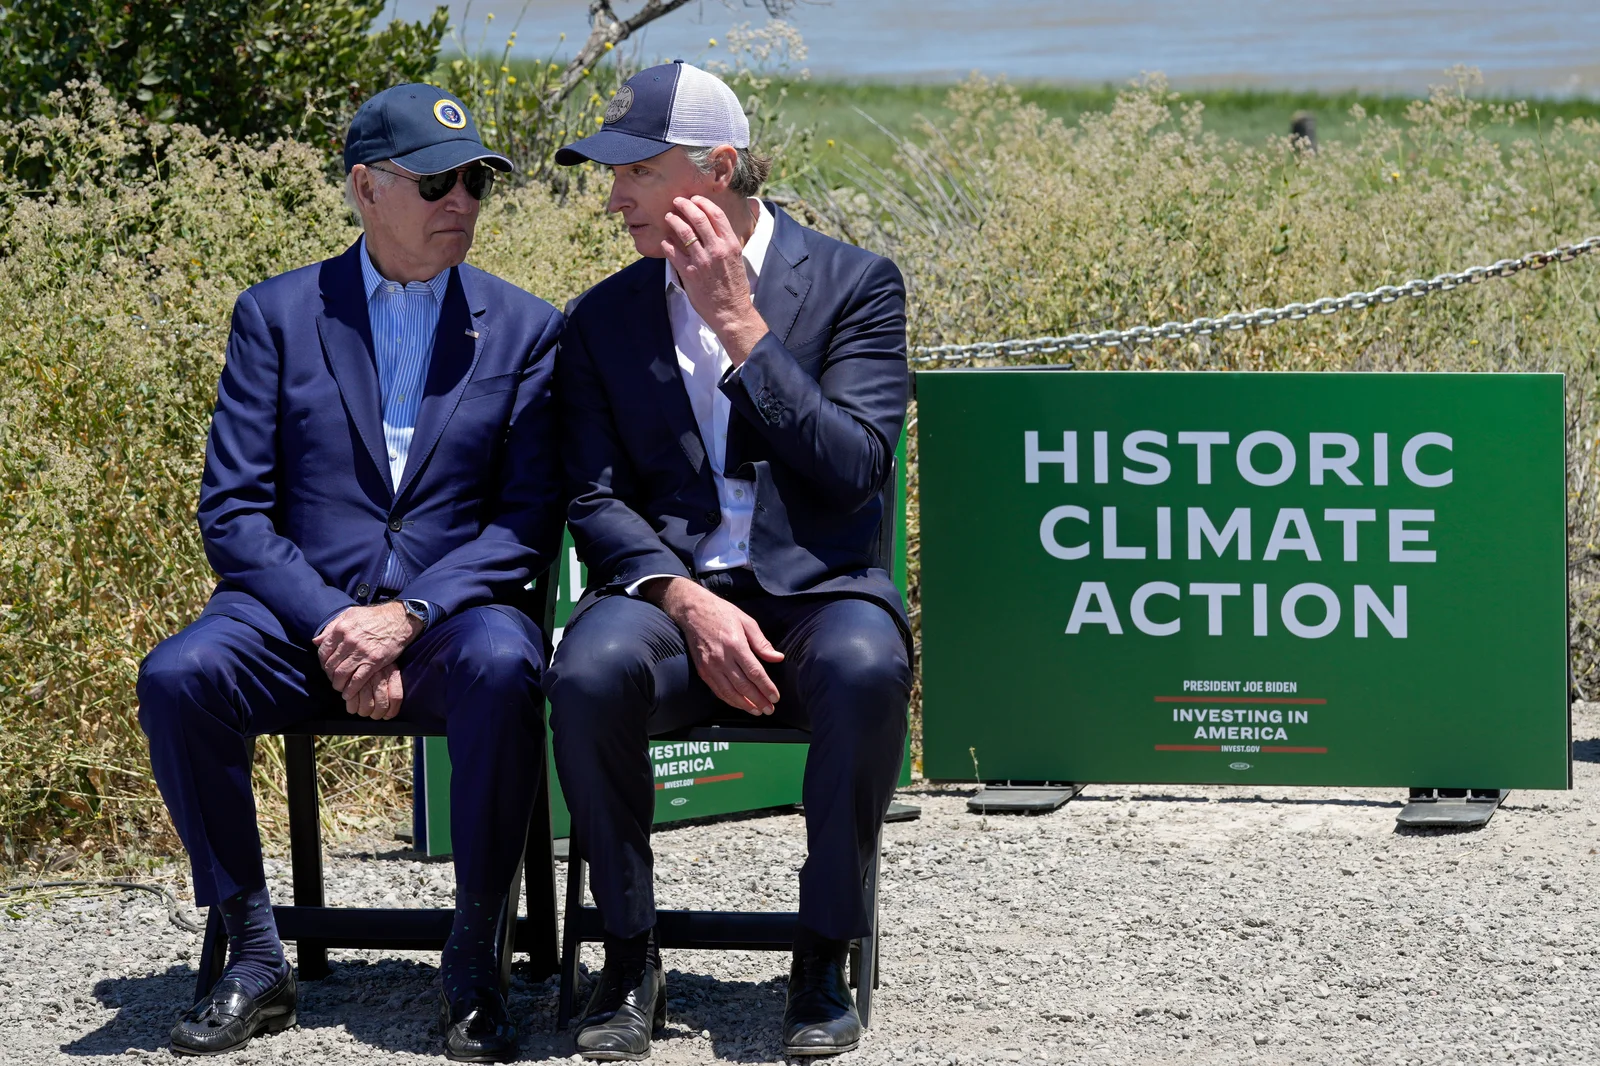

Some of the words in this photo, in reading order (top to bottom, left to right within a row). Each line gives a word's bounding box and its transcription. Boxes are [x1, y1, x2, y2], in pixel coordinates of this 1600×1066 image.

[1024, 430, 1453, 487] HISTORIC
[1040, 505, 1437, 563] CLIMATE
[1065, 581, 1408, 639] ACTION
[1183, 680, 1241, 692] PRESIDENT
[1242, 681, 1263, 693] JOE
[1265, 681, 1297, 693] BIDEN
[1173, 708, 1283, 724] INVESTING
[1288, 710, 1308, 724] IN
[1193, 726, 1288, 741] AMERICA
[649, 741, 710, 760] VESTING
[713, 741, 729, 752] IN
[1221, 744, 1260, 753] INVEST.GOV
[654, 757, 714, 777] MERICA
[664, 778, 694, 789] INVEST.GOV
